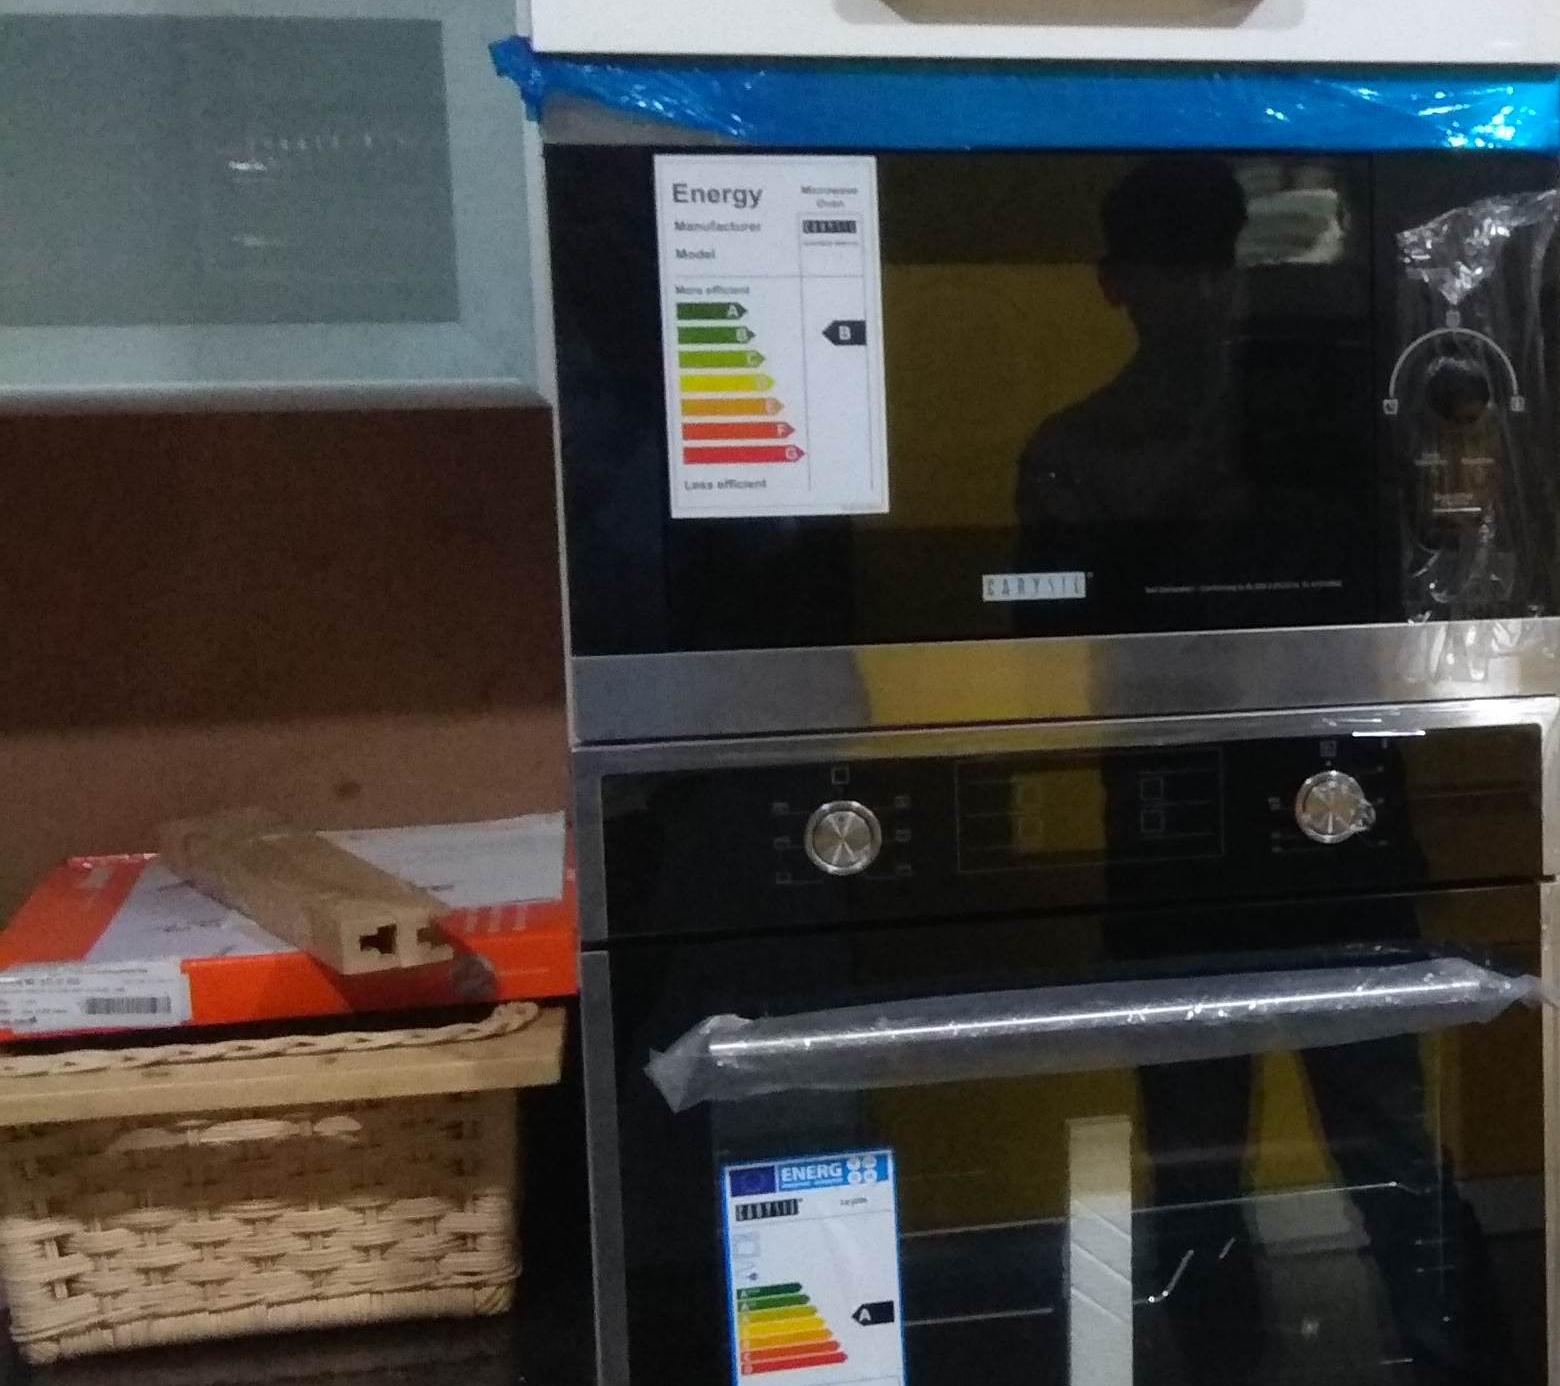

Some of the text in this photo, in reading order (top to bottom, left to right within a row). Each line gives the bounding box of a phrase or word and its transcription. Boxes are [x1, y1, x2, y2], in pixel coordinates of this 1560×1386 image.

[672, 182, 763, 209] Energy
[801, 185, 858, 196] Microwave
[674, 220, 762, 232] Manufacturer
[675, 248, 716, 260] Model
[674, 284, 750, 295] More efficient
[727, 304, 739, 317] A
[838, 325, 852, 341] B
[684, 478, 767, 491] Less efficient
[983, 572, 1085, 601] CARYSIL
[781, 1163, 843, 1183] ENERG
[859, 1308, 872, 1322] A
